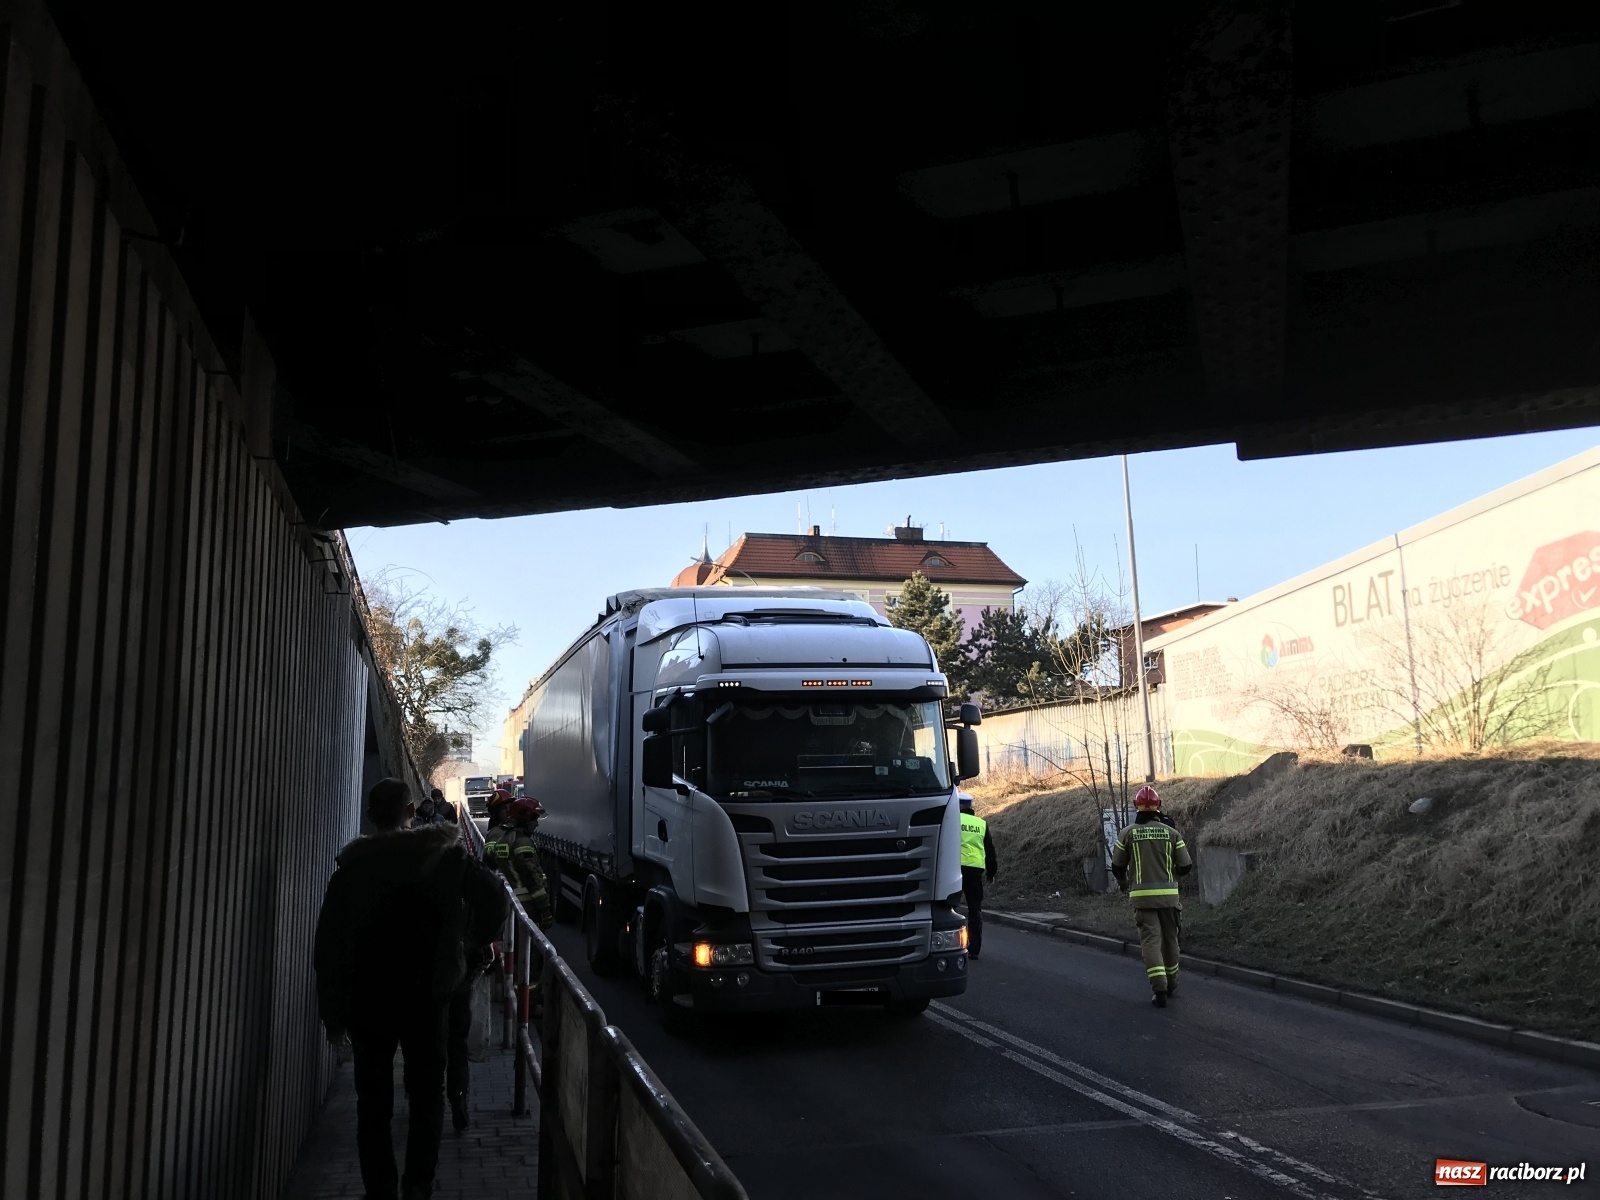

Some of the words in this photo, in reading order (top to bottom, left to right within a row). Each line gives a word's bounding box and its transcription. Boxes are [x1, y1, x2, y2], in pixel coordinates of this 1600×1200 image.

[1332, 569, 1395, 628] BLAT
[1428, 562, 1511, 609] życzenie
[1318, 669, 1376, 693] RACIBORZ
[743, 780, 789, 789] SCANIA
[793, 809, 892, 830] SCANIA
[960, 824, 981, 834] OLICJA
[781, 948, 790, 957] R
[791, 947, 814, 956] 440
